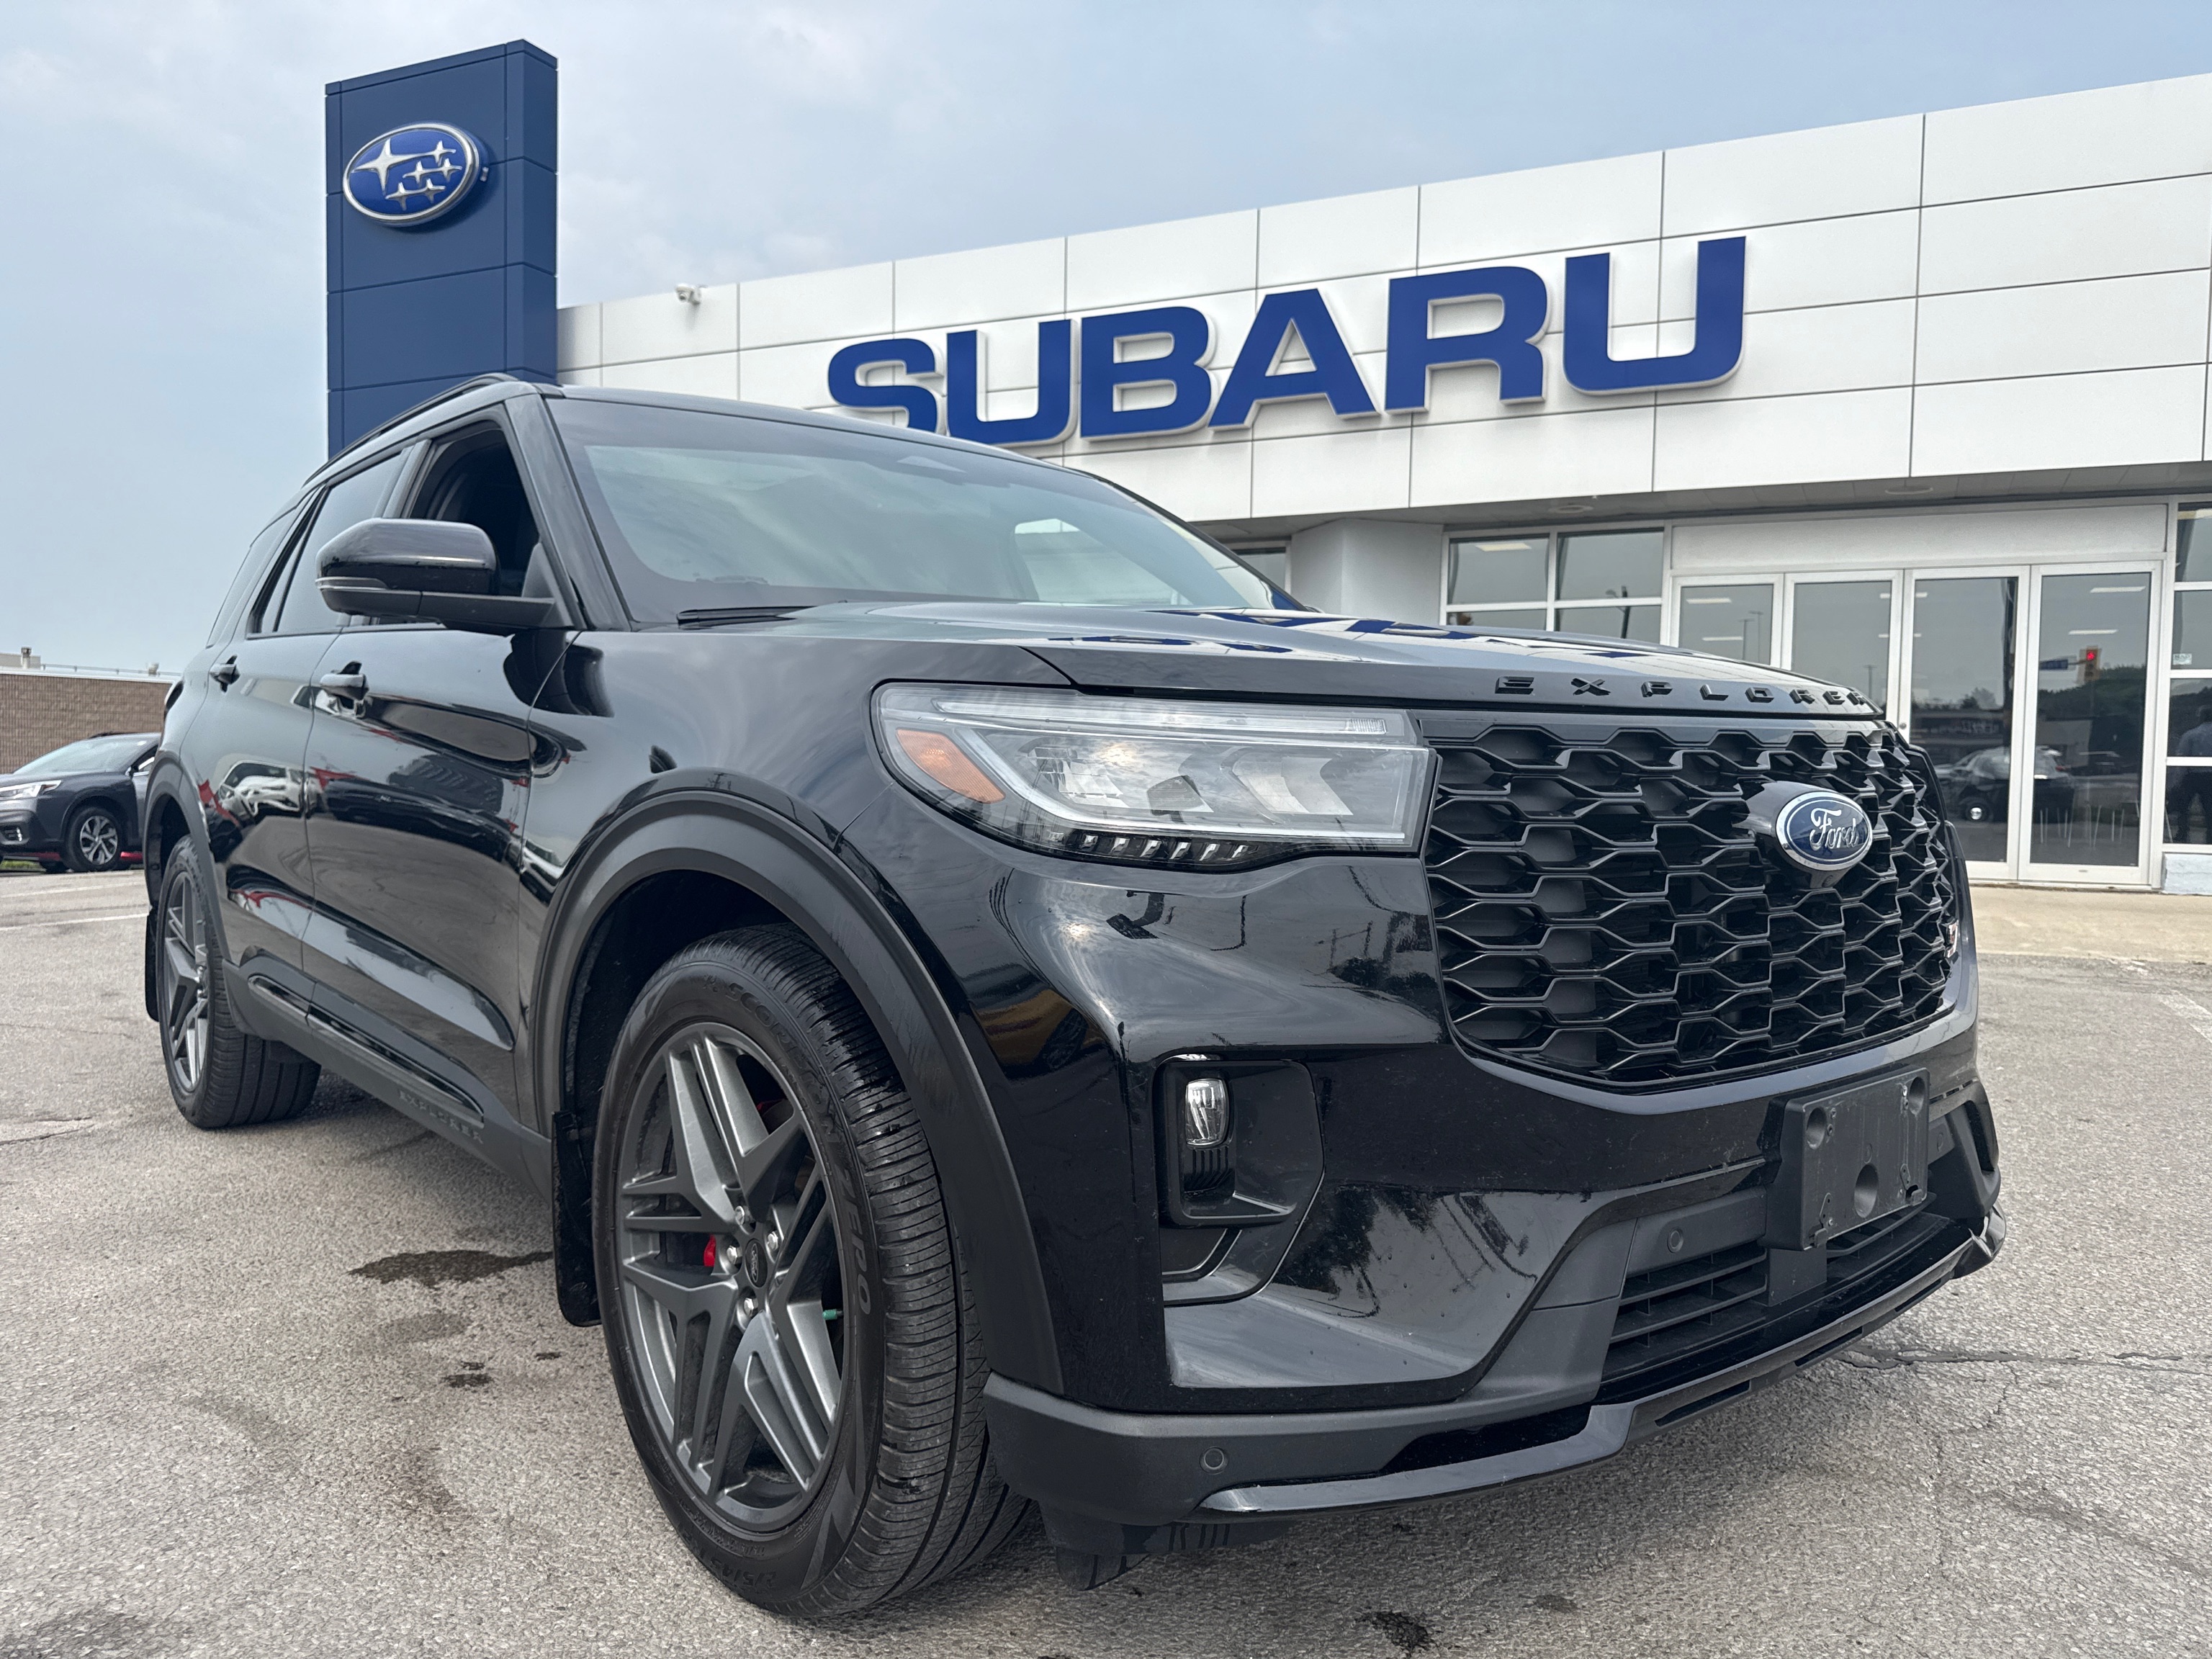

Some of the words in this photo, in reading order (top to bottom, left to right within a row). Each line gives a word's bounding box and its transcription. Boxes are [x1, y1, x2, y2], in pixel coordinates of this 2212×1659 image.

[827, 235, 1746, 443] SUBARU
[1495, 675, 1869, 706] EXPLORER
[1809, 807, 1860, 851] Ford
